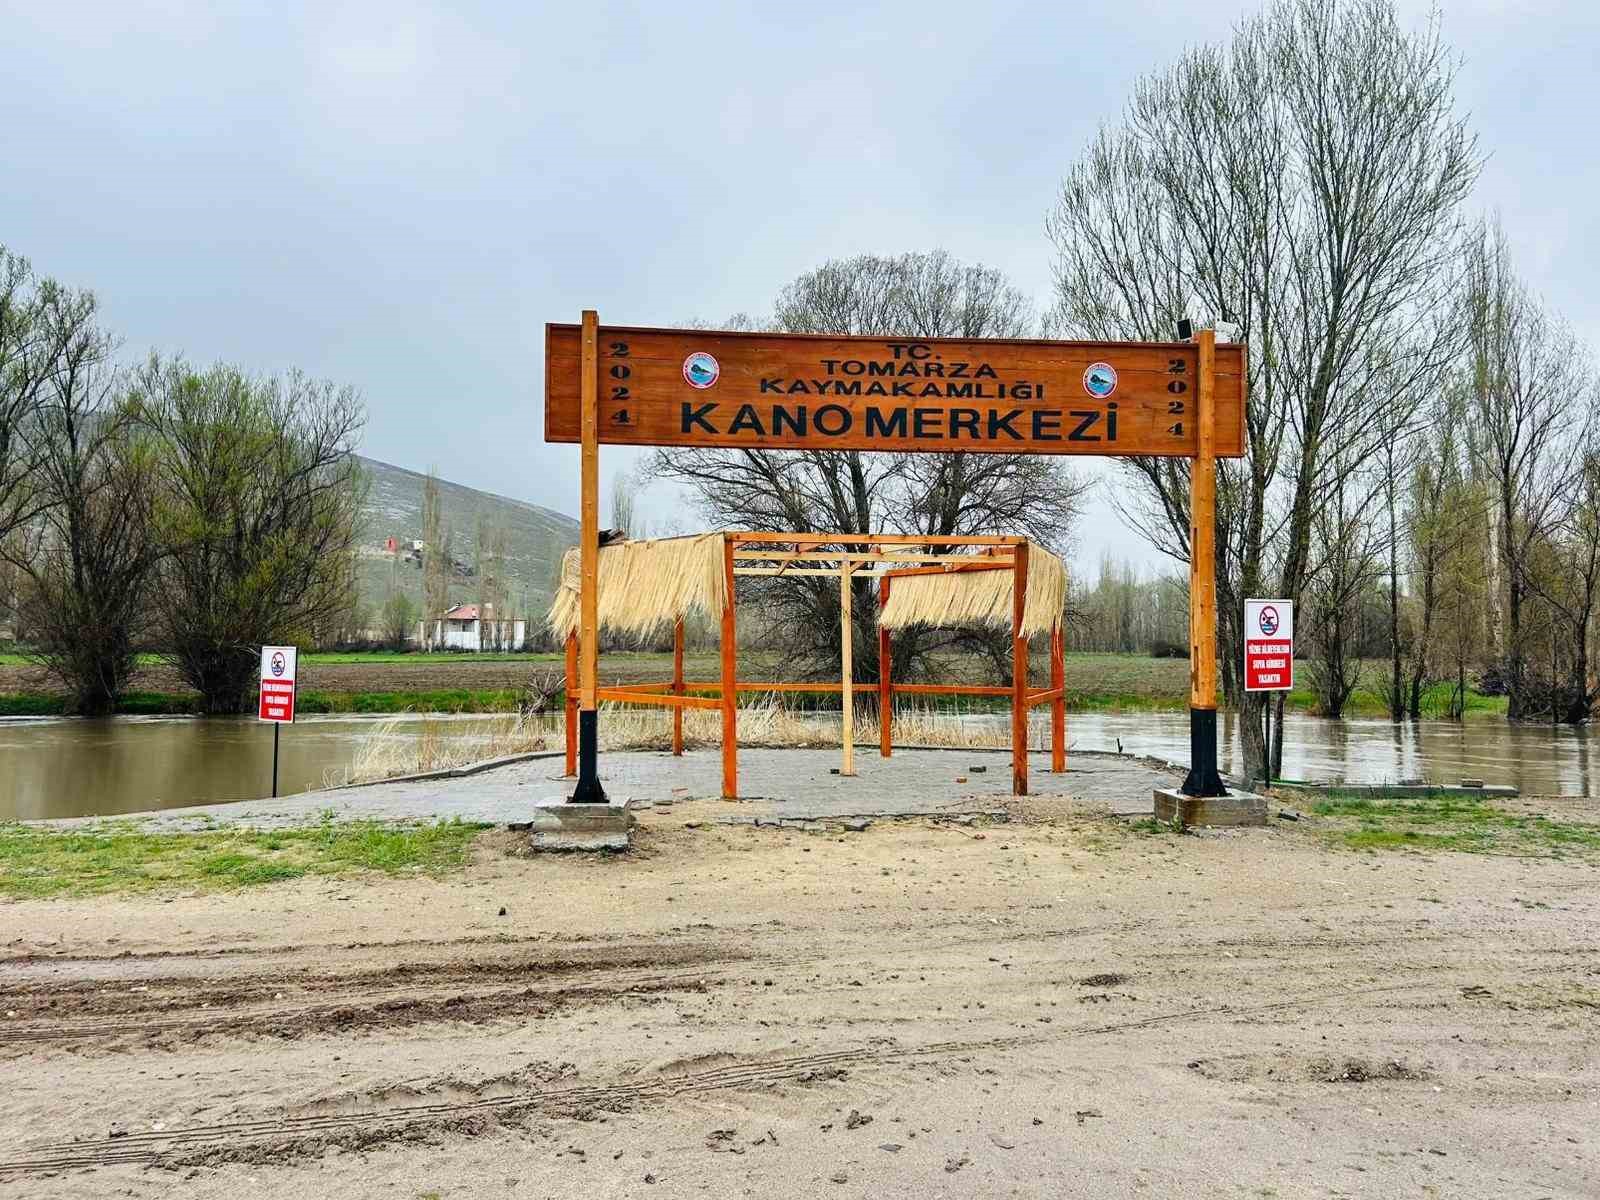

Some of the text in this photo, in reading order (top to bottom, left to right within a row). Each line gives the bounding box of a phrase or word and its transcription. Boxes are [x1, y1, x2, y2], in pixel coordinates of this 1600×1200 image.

[609, 342, 631, 424] 2024
[760, 378, 1043, 400] KAYMAKAMLIĞI
[820, 359, 999, 379] TOMARZA
[1167, 359, 1187, 437] 2024
[680, 402, 1118, 442] KANO MERKEZİ
